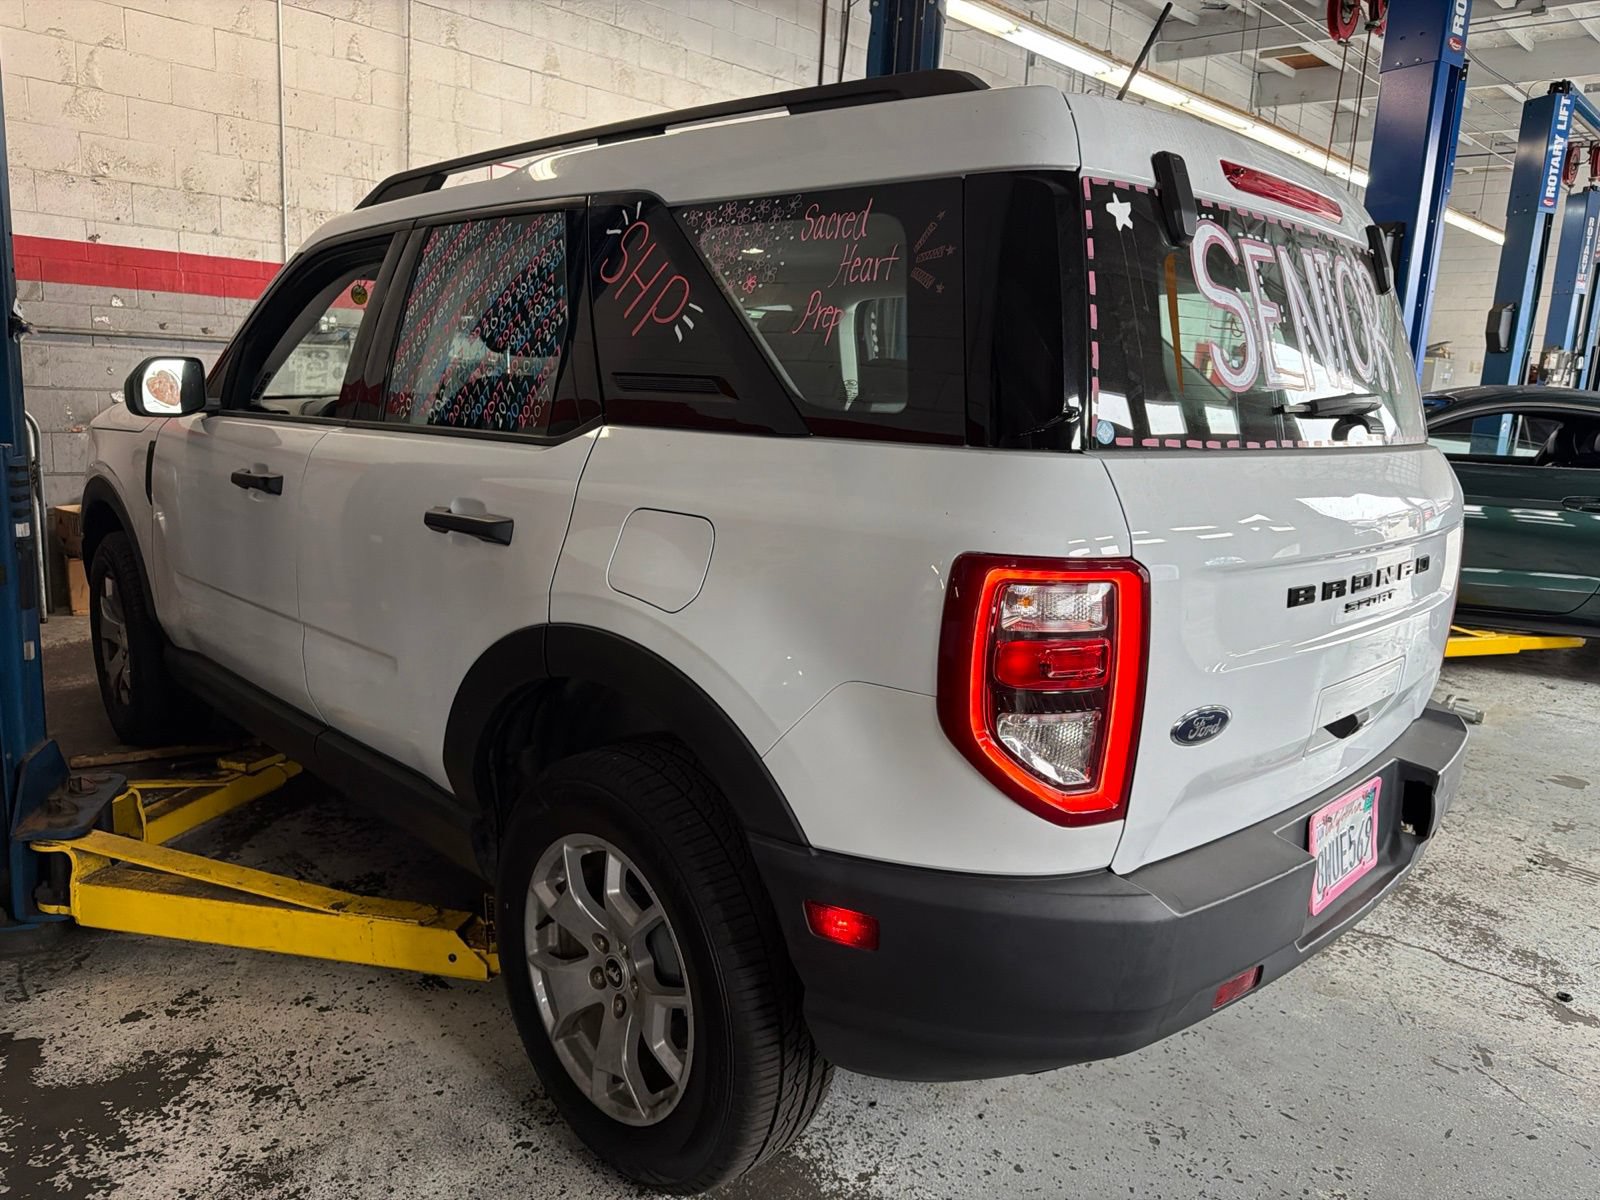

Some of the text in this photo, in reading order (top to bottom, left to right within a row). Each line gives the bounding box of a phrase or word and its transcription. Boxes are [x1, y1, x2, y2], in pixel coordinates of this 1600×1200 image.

[1545, 96, 1571, 198] ROTARY LIFT
[800, 198, 873, 242] Sacred
[600, 221, 690, 336] SHP
[828, 244, 900, 288] Heart
[792, 290, 845, 346] Prep
[1286, 554, 1431, 608] BRONCO
[1187, 715, 1222, 741] Ford
[1316, 815, 1372, 895] 8HUE569
